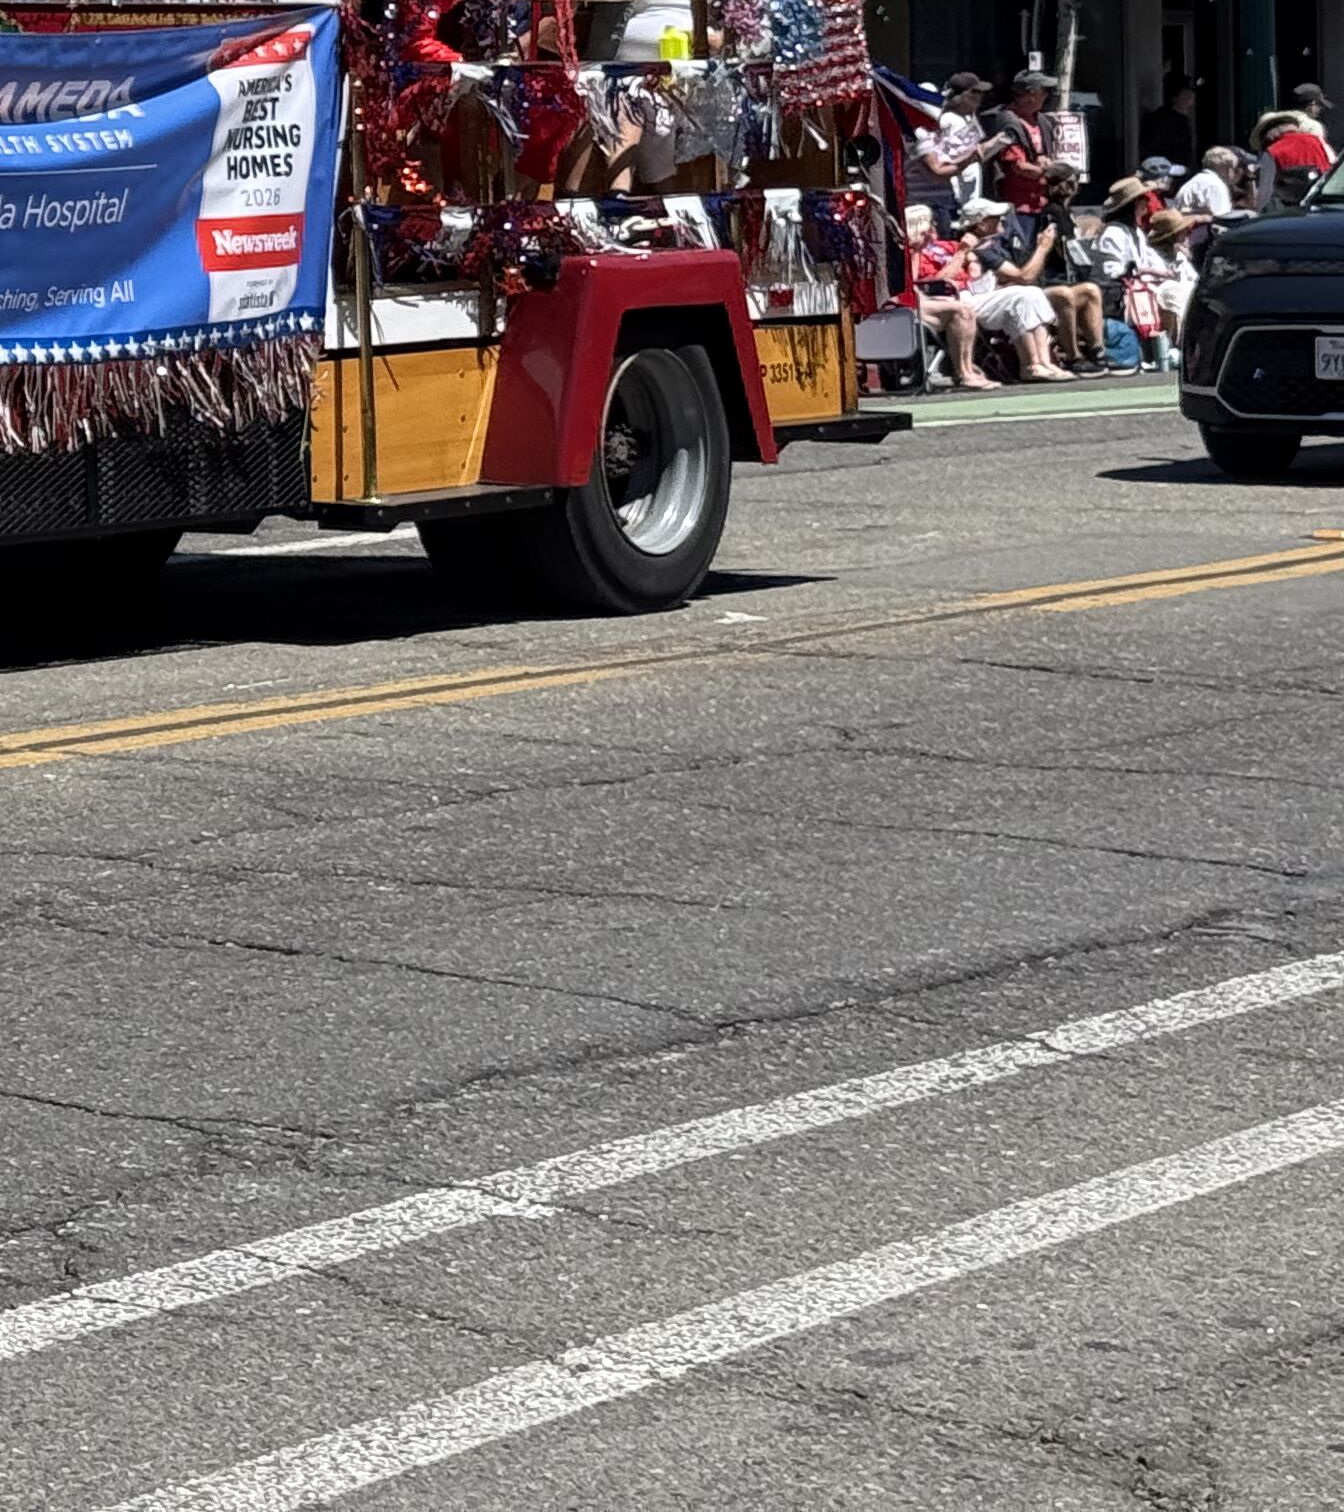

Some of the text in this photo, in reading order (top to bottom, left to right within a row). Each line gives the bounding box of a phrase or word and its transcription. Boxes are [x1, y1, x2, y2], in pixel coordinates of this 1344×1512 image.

[238, 73, 293, 99] AMERICA'S
[242, 97, 279, 123] BEST
[45, 129, 133, 153] SYSTEM
[224, 123, 301, 150] NURSING
[226, 153, 293, 181] HOMES
[22, 188, 130, 232] Hospital
[241, 188, 281, 208] 2026
[212, 225, 297, 257] Newsweek
[44, 284, 105, 308] Serving
[111, 280, 135, 302] All
